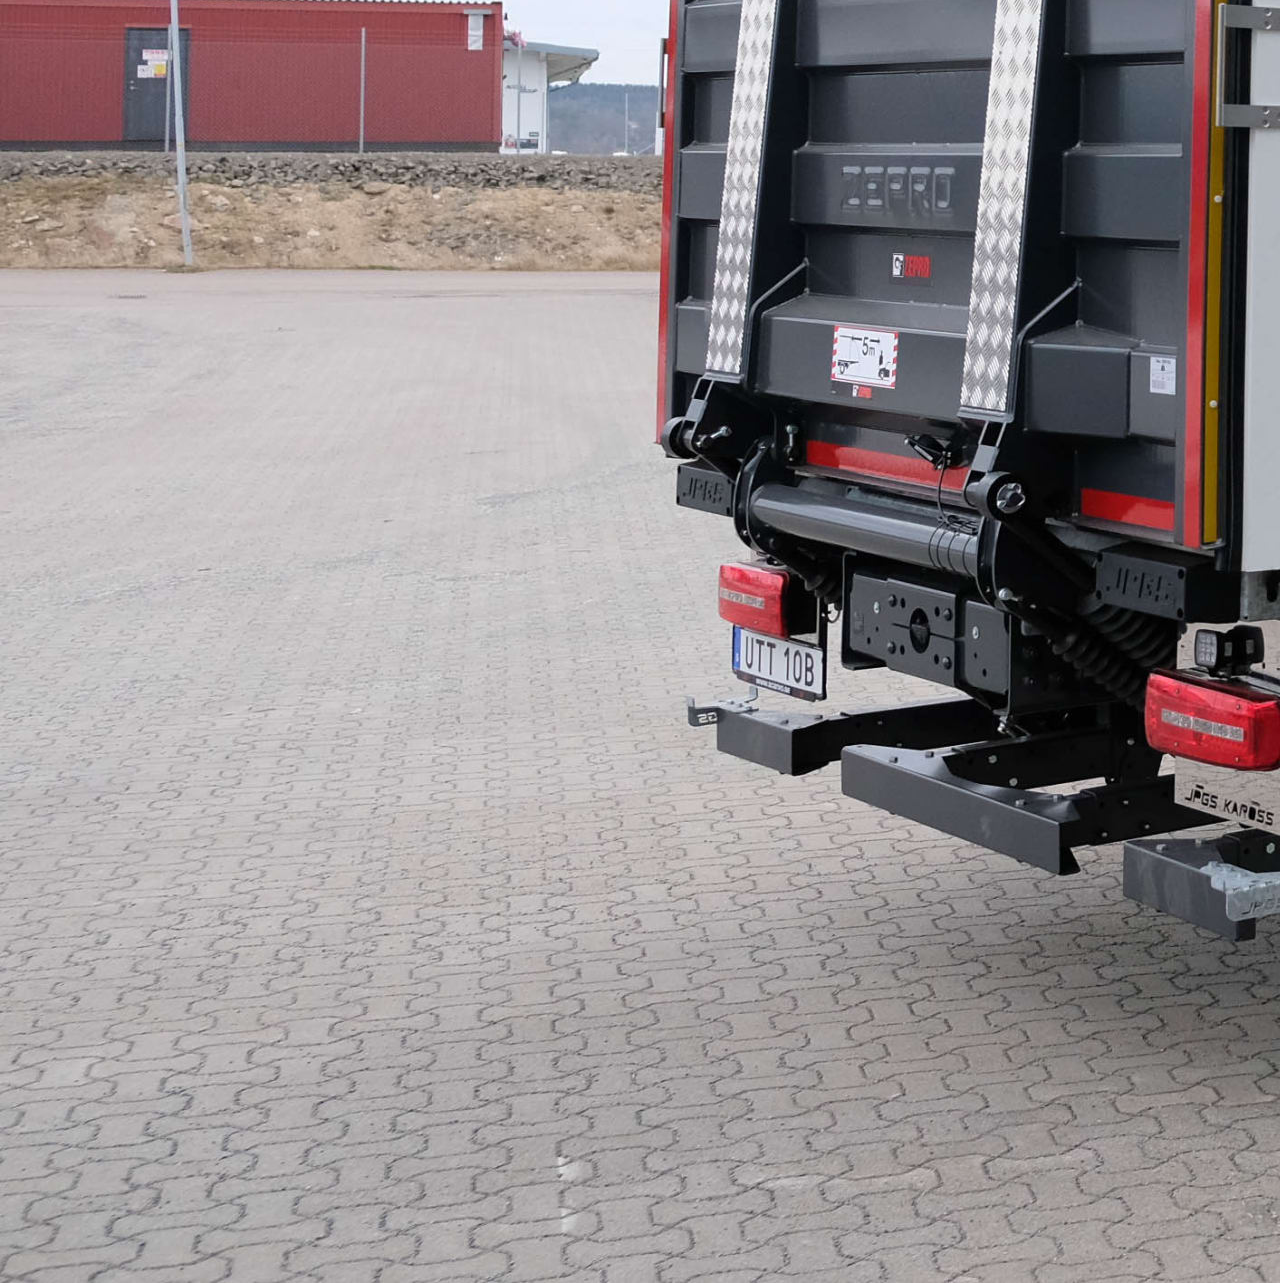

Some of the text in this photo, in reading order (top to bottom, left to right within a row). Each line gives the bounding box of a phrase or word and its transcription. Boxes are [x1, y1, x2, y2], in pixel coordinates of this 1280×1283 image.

[842, 166, 955, 217] ZEPRO
[905, 255, 931, 278] ZEPRO
[745, 636, 815, 687] UTT 10B
[1185, 788, 1275, 826] JPGS KAROSS
